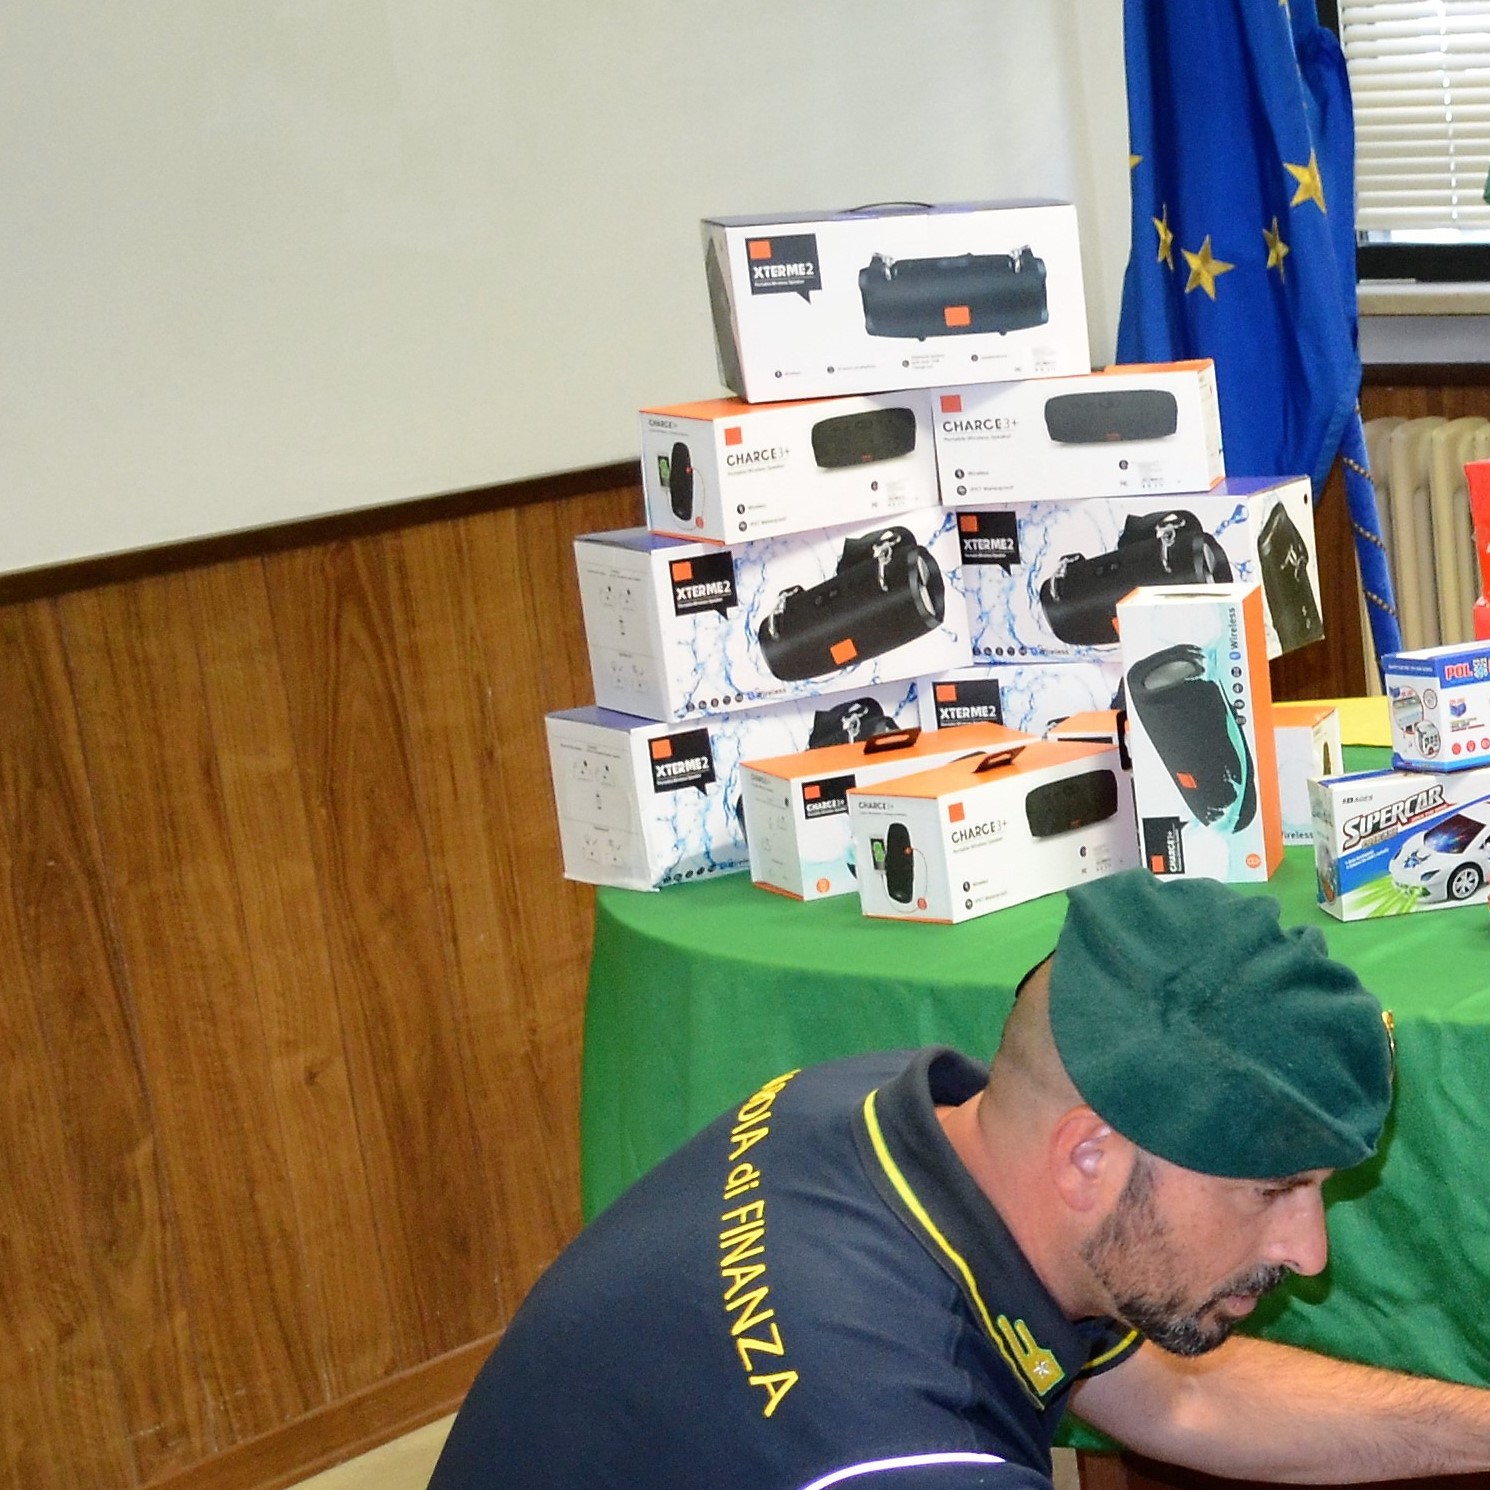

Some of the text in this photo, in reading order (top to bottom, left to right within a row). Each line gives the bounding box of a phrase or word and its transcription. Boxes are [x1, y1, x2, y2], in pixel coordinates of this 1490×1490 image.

[753, 263, 815, 279] XTERME2
[963, 537, 1015, 550] XTERME2
[676, 580, 732, 601] XTERME2
[939, 705, 997, 720] XTERME2
[655, 756, 710, 778] XTERME2
[1343, 784, 1447, 852] SUPERCAR
[723, 1162, 760, 1200] di
[719, 1200, 799, 1418] FINANZA
